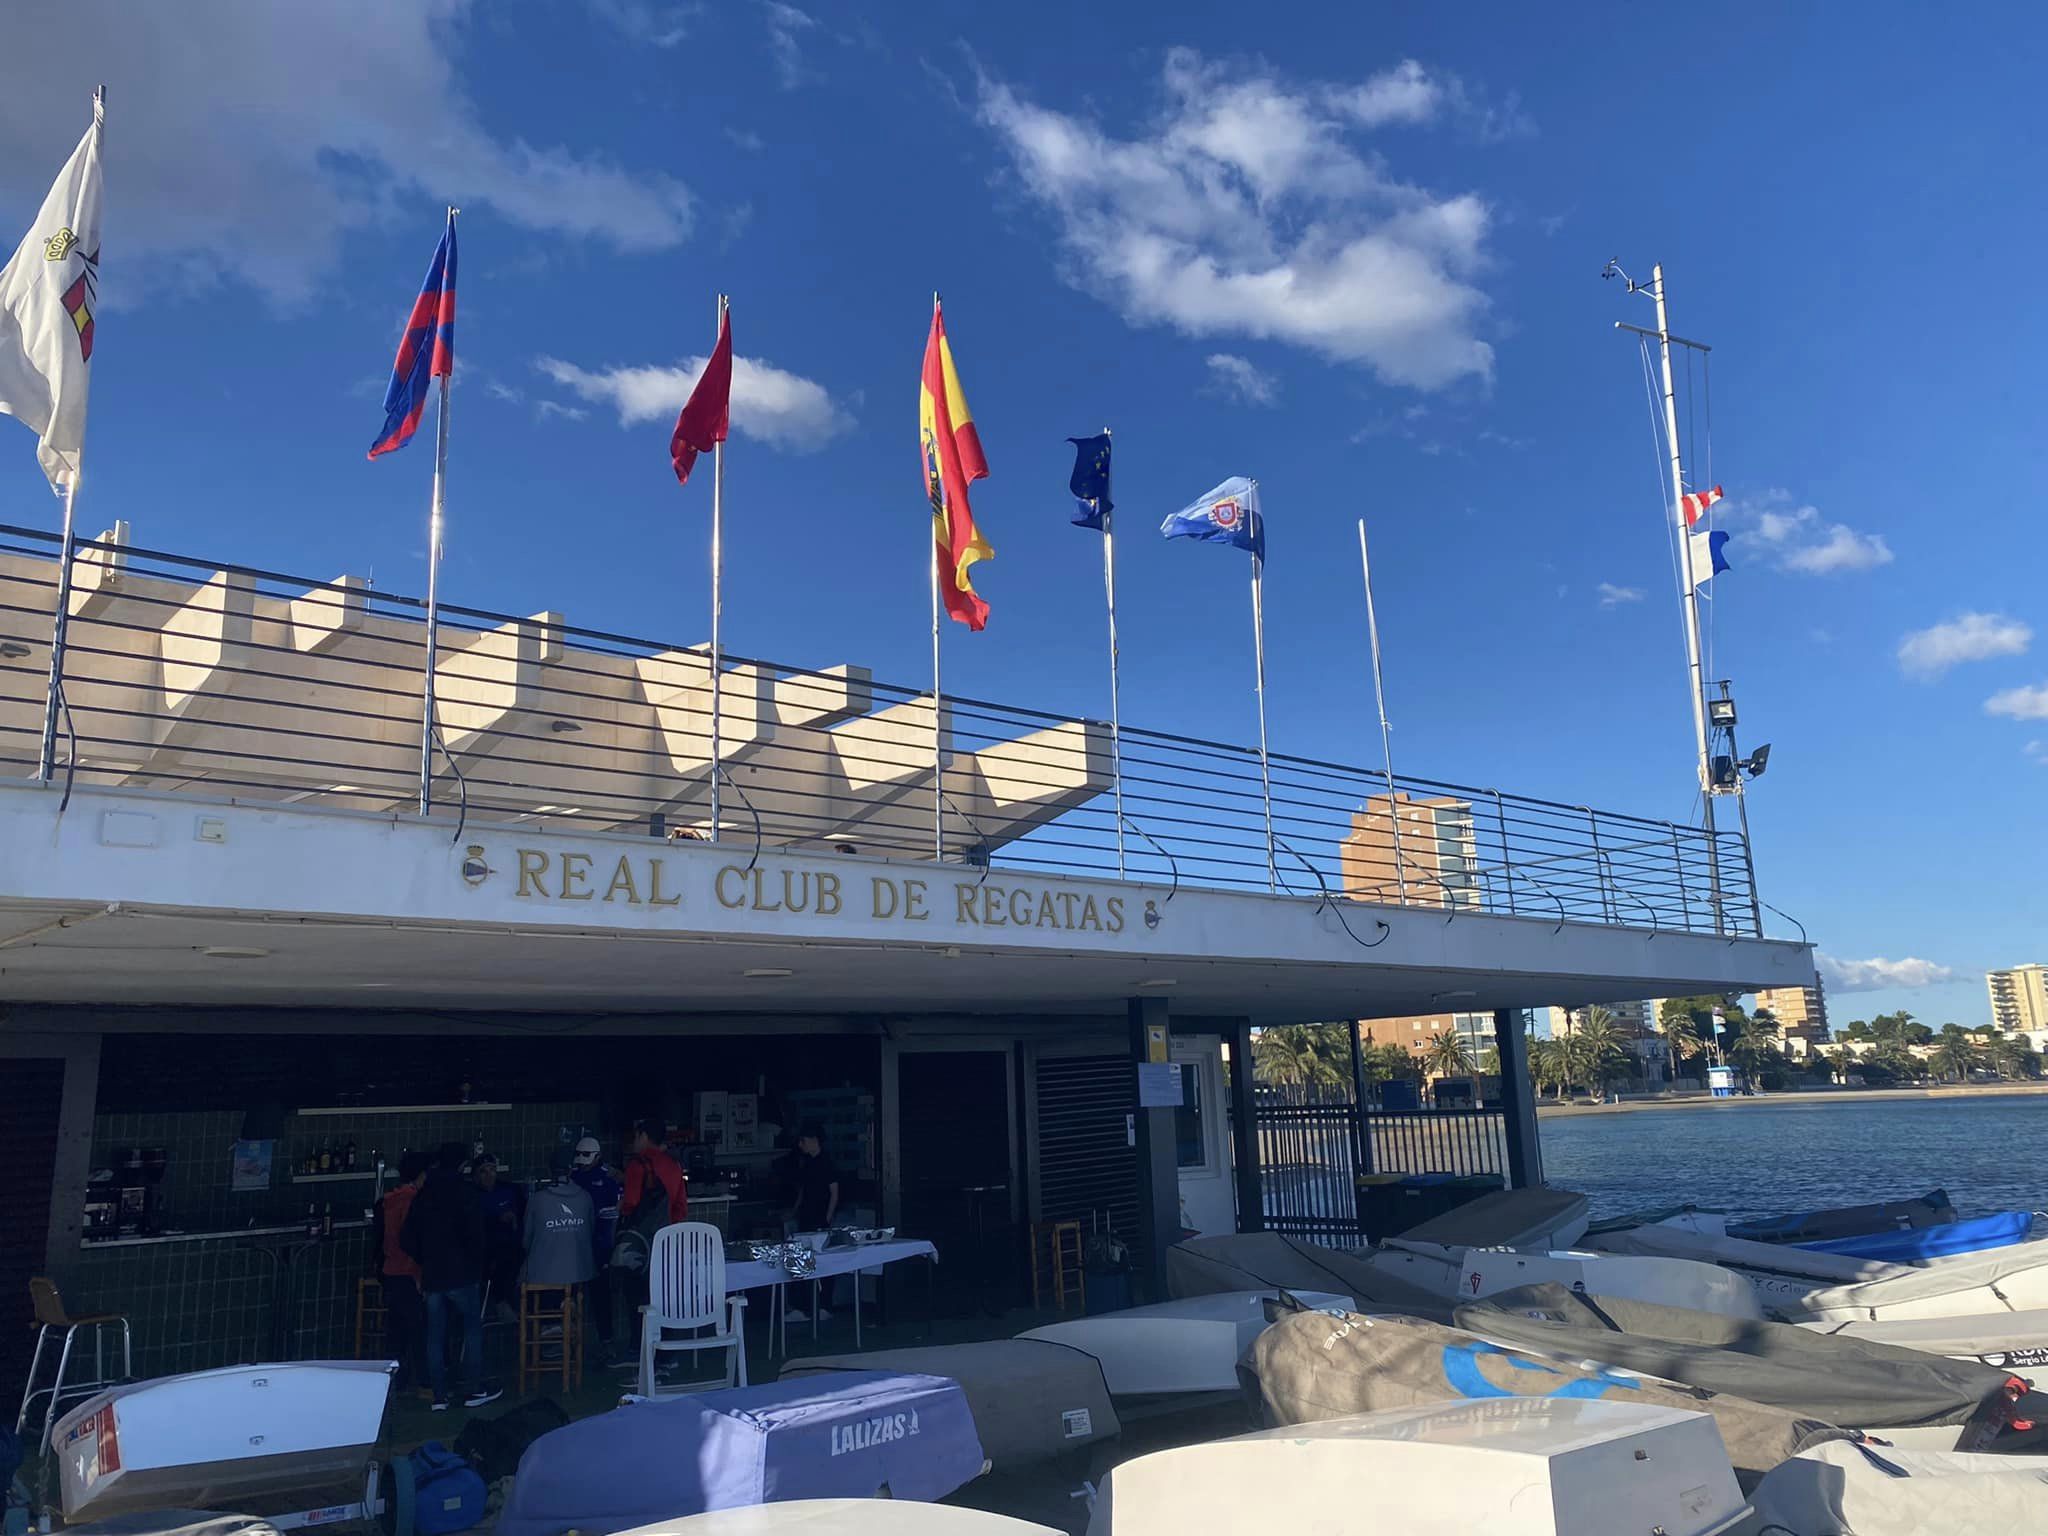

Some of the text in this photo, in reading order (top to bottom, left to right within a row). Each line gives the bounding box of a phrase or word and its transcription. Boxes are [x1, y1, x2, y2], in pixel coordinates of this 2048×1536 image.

[516, 849, 1124, 932] REAL CLUB DE REGATAS
[2012, 1356, 2040, 1366] Sergio
[831, 1413, 906, 1456] LALIZAS
